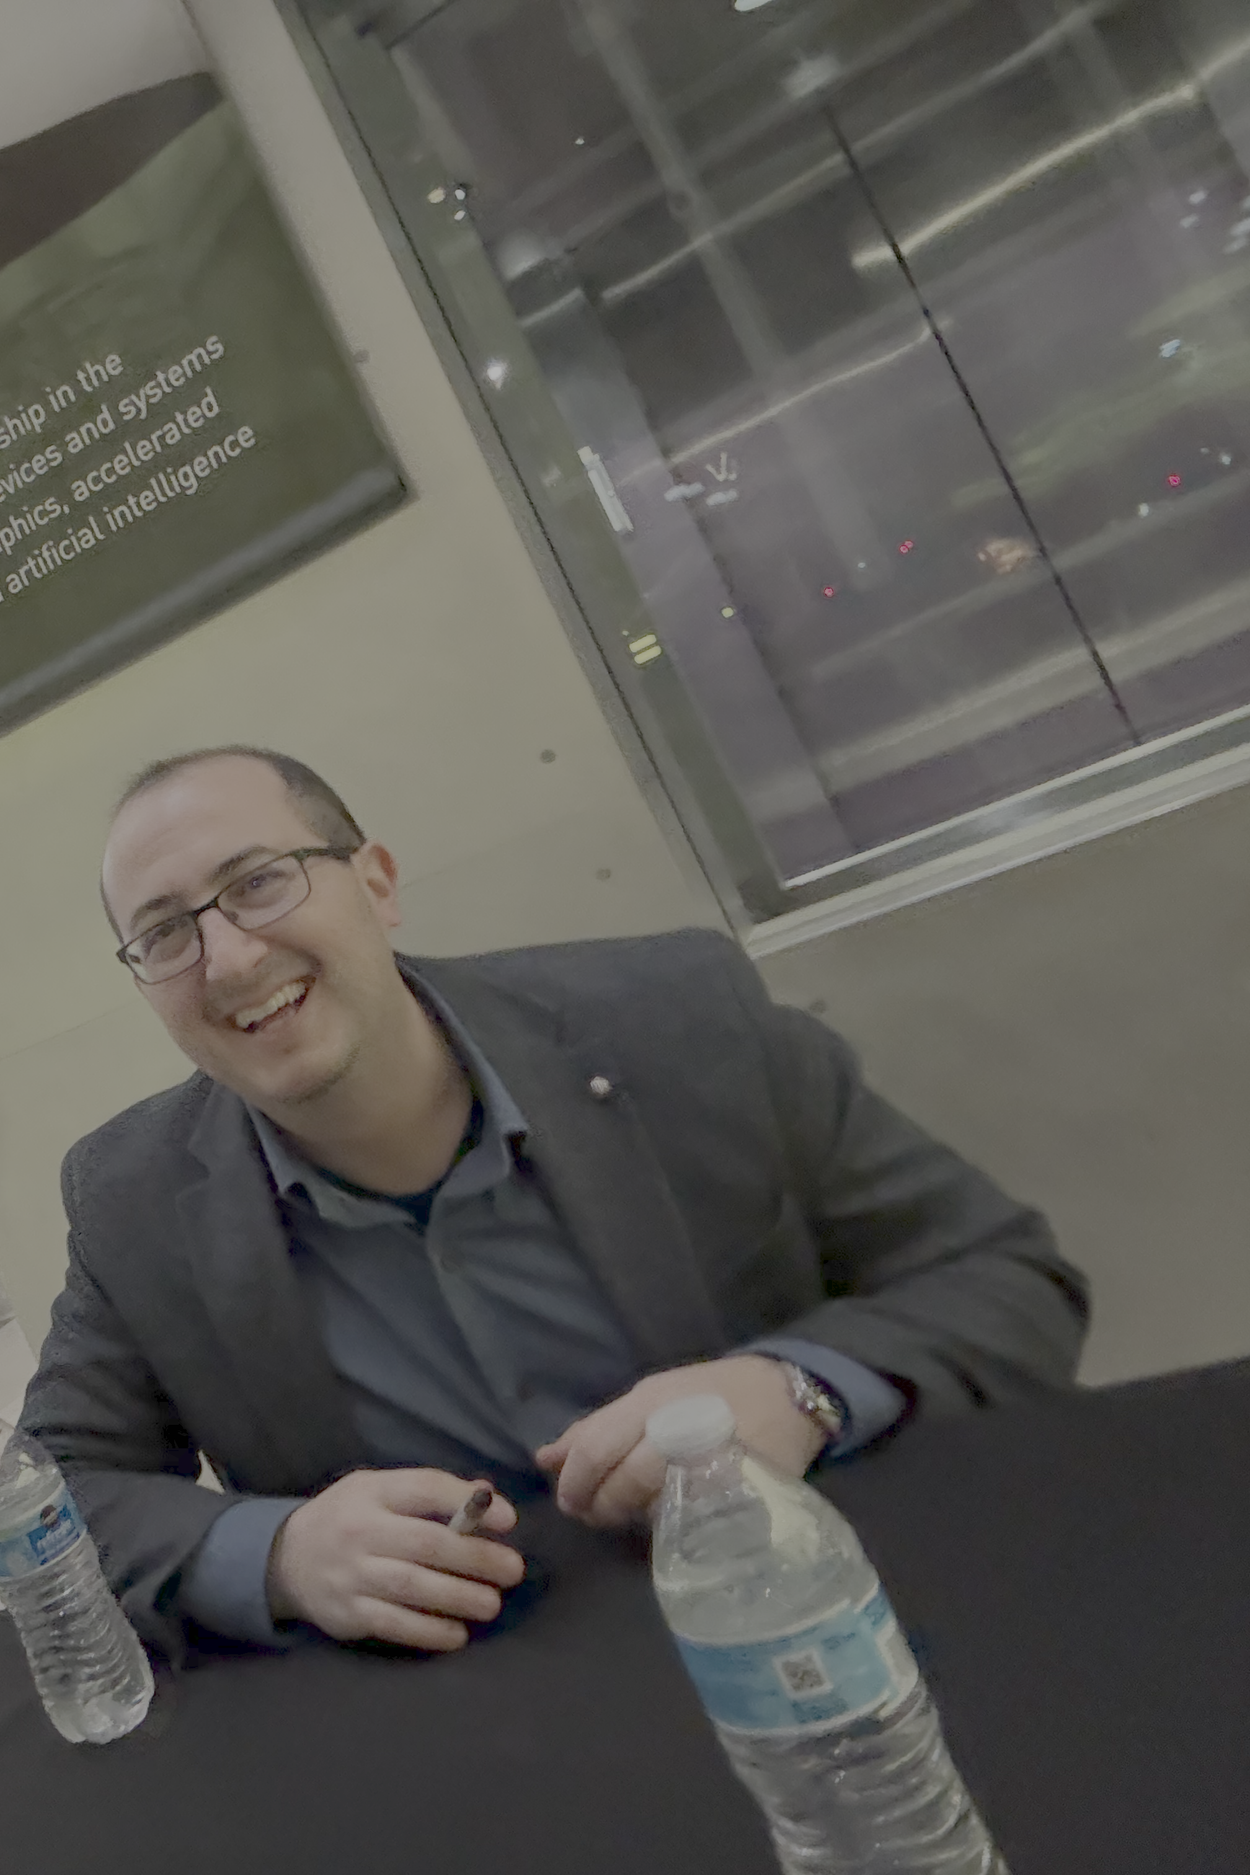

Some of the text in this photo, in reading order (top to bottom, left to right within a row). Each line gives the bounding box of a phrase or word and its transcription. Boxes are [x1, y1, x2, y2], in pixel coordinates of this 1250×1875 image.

[46, 385, 76, 413] in
[76, 353, 124, 392] the
[65, 404, 115, 454] and
[118, 335, 224, 420] systems
[71, 386, 219, 502] accelerated
[6, 516, 105, 594] artificial
[105, 426, 255, 532] intelligence
